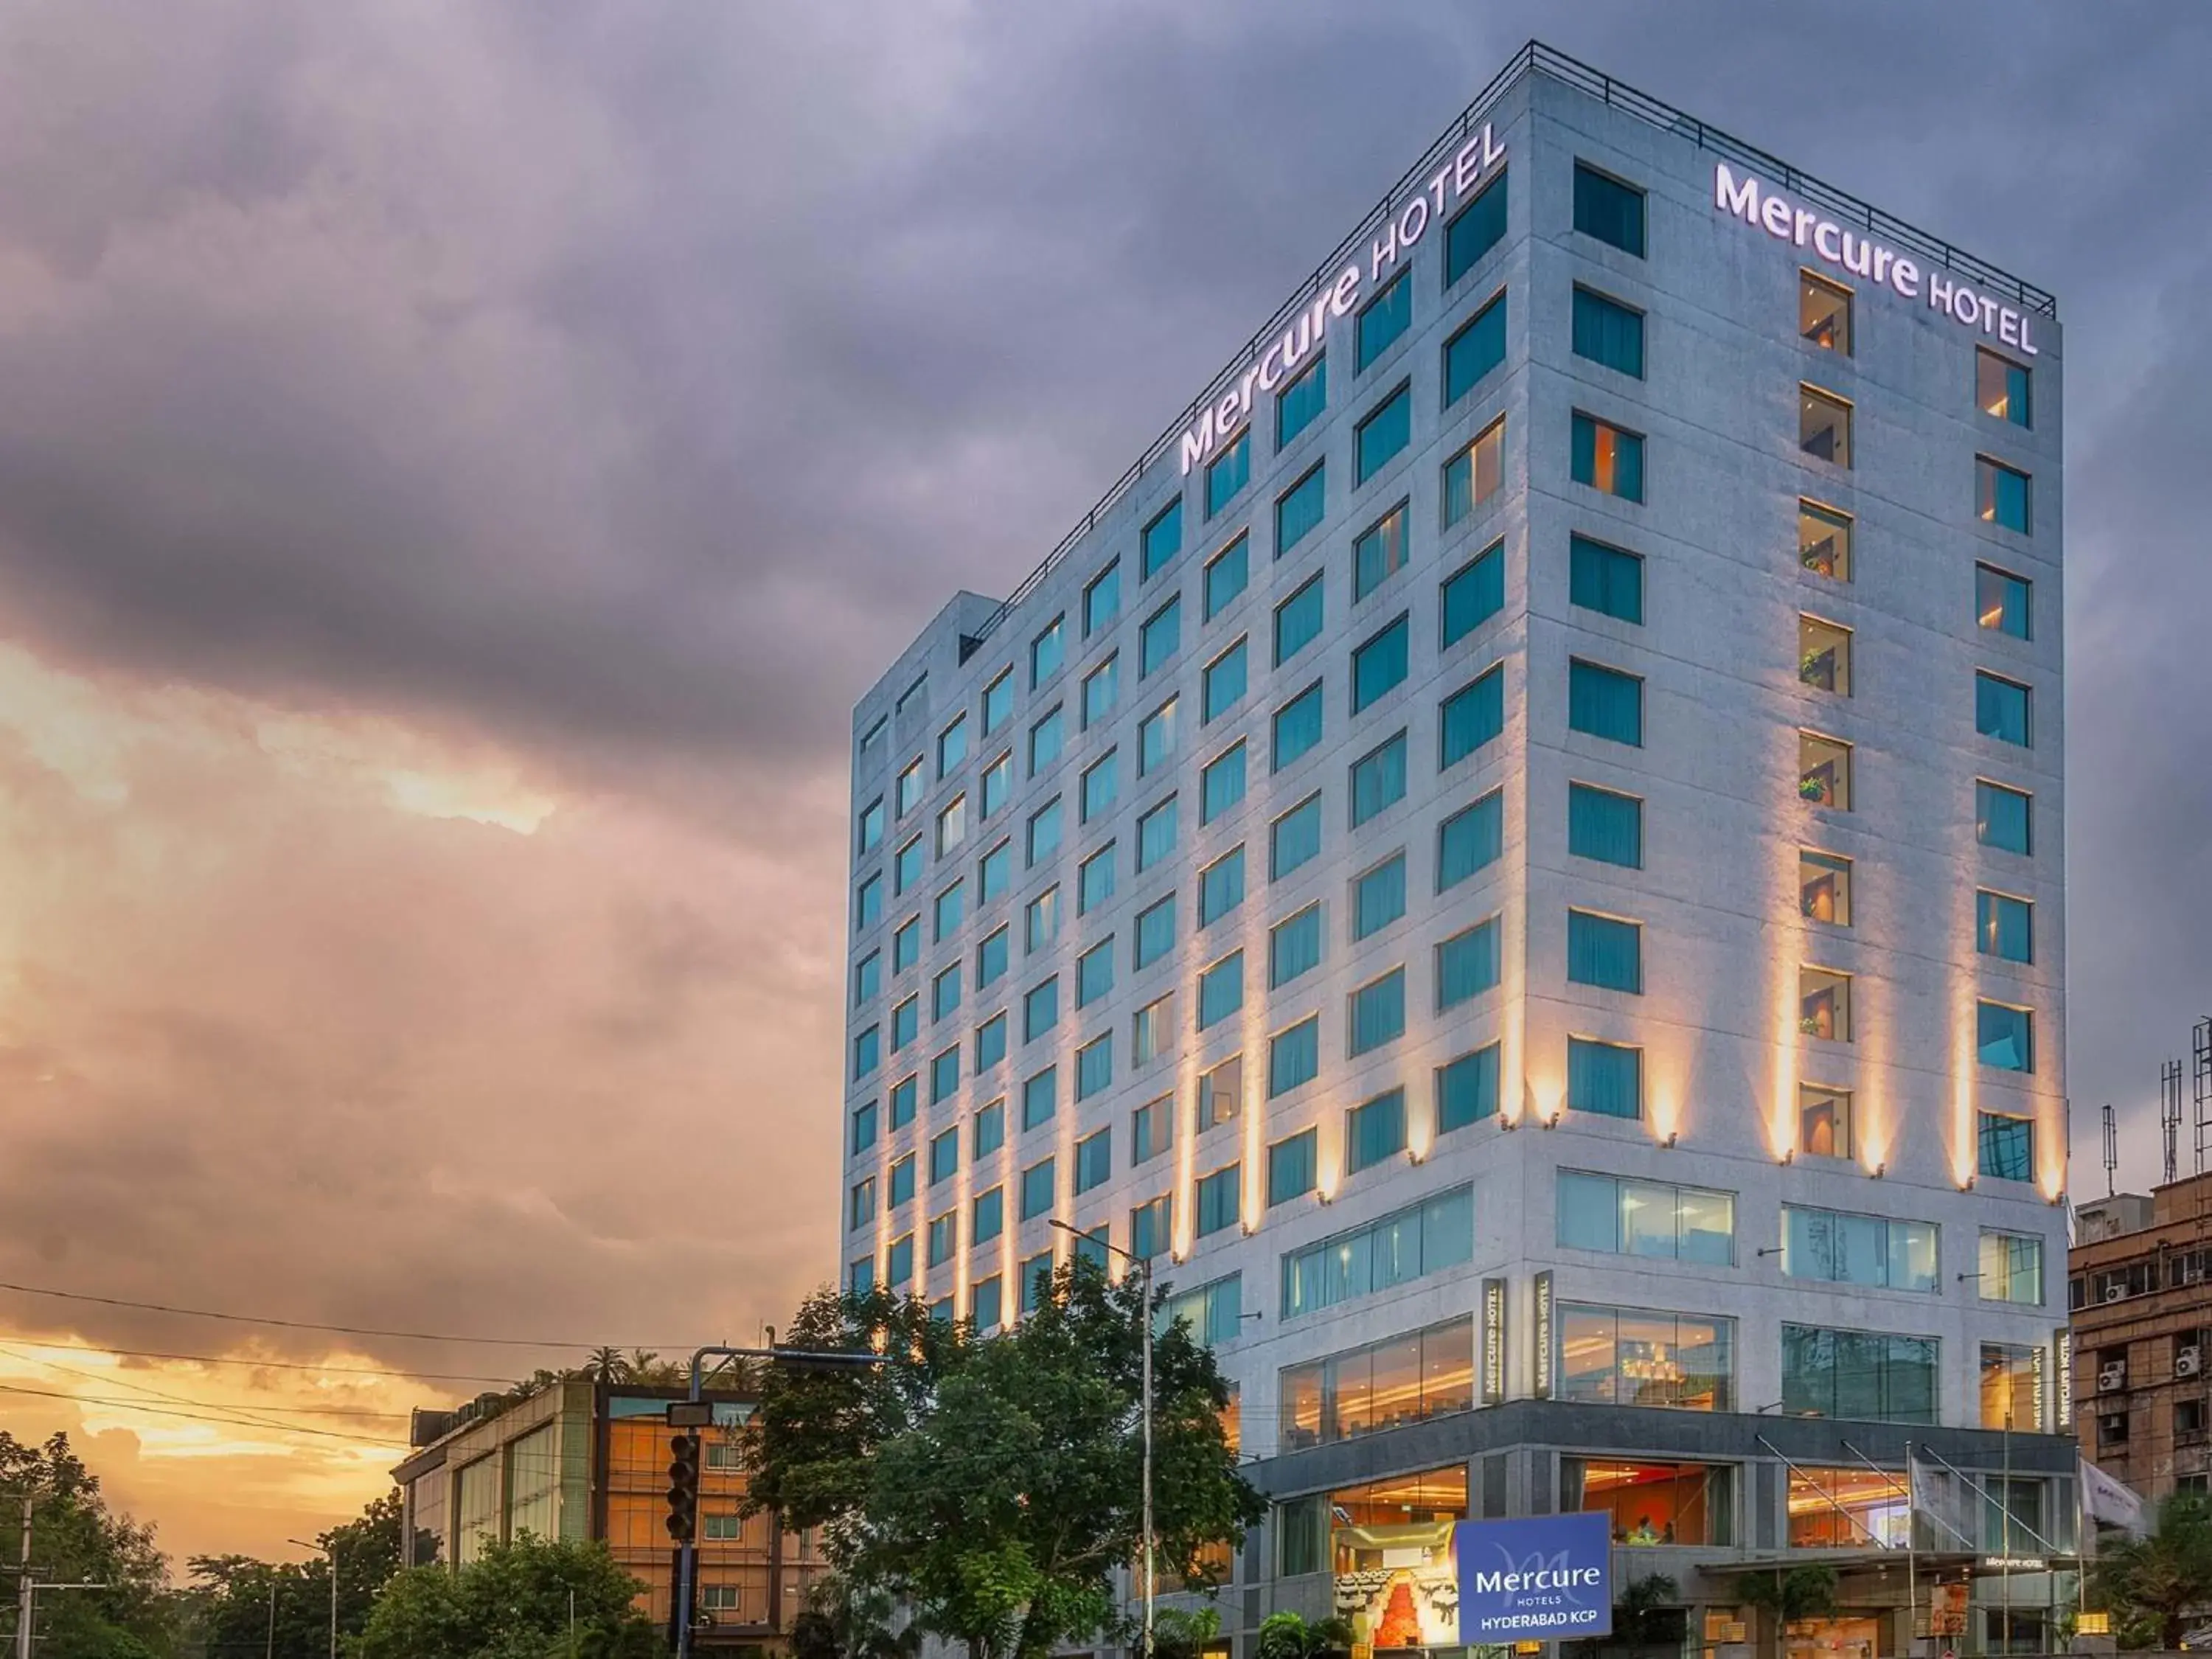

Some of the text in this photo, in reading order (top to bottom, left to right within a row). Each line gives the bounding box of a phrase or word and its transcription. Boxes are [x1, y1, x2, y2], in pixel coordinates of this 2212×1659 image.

[1715, 163, 2038, 355] Mercure HOTEL
[1180, 122, 1506, 476] Mercure HOTEL
[1476, 1567, 1600, 1593] Mercure
[1517, 1596, 1562, 1607] HOTELS
[1481, 1610, 1597, 1630] HYDERABAD KCP
